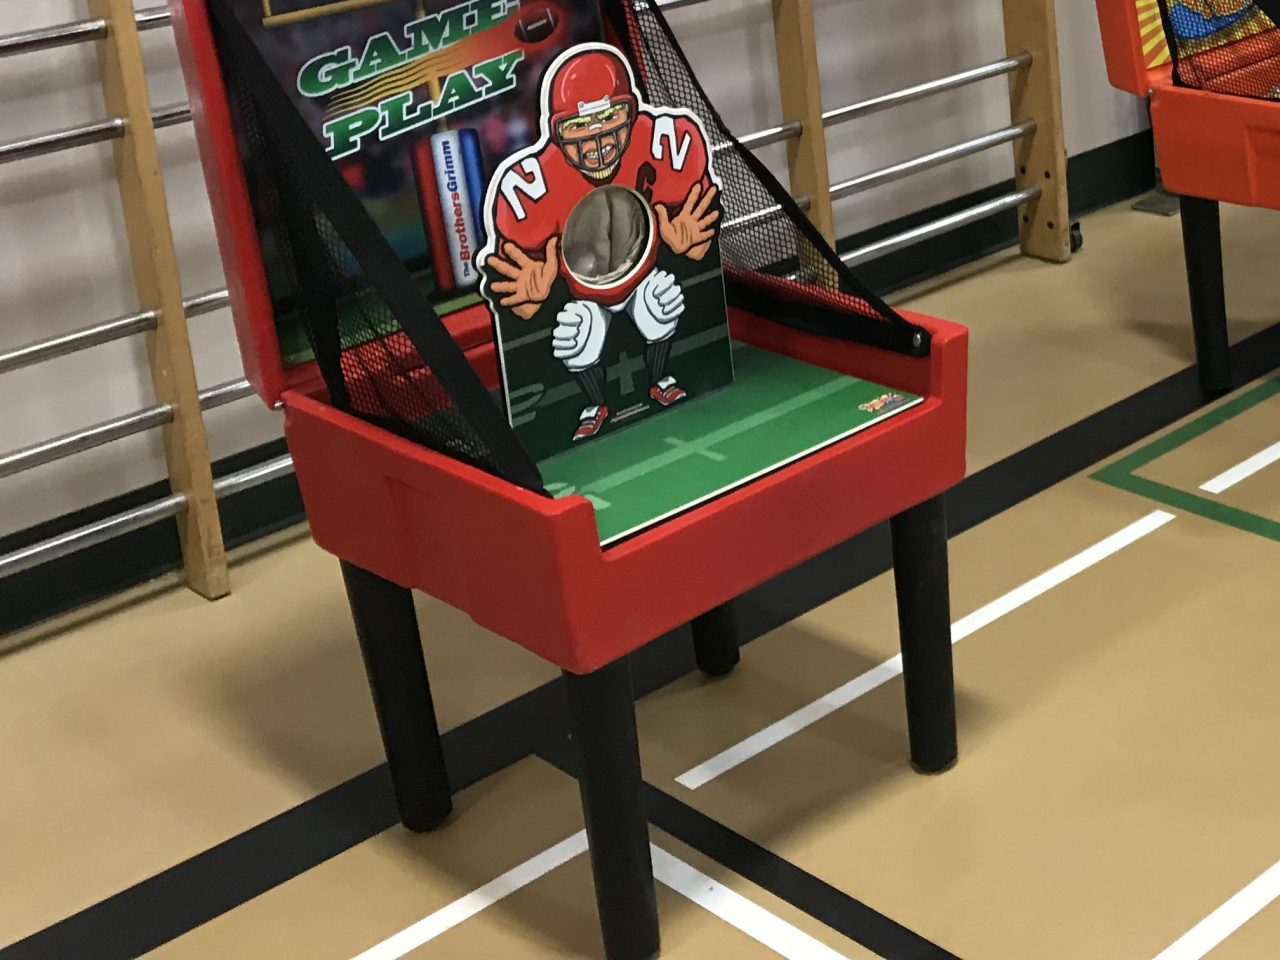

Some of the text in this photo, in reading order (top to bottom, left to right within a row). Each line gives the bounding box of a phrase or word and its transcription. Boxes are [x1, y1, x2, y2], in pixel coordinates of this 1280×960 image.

[322, 48, 525, 161] PLAY
[652, 115, 691, 171] 2
[500, 157, 547, 221] 2
